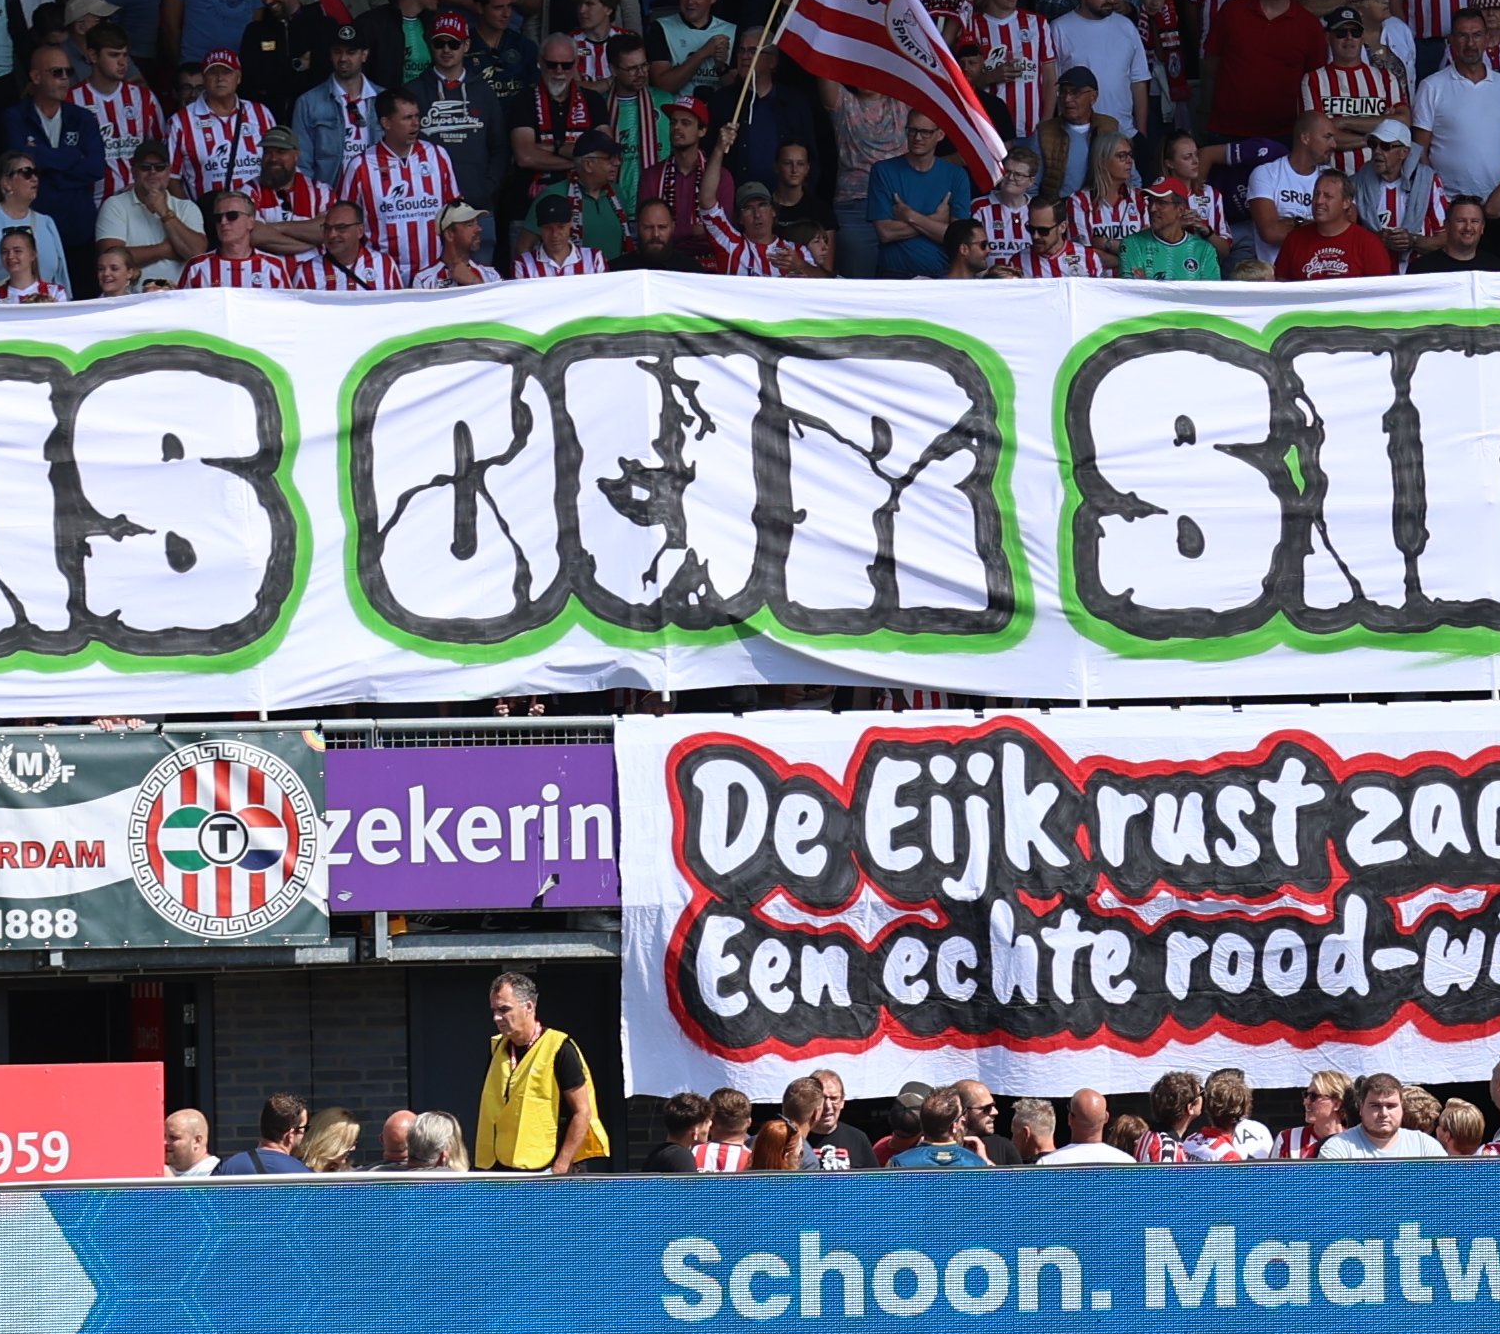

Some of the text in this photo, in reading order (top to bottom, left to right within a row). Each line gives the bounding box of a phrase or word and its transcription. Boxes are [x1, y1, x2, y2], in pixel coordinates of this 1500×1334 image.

[420, 107, 483, 131] Superdry
[1322, 98, 1386, 116] EFTELING
[204, 157, 217, 169] de
[378, 196, 437, 212] de Goudse
[695, 758, 830, 878] De
[864, 741, 1070, 902] Eijk
[1098, 756, 1327, 868] rust
[209, 824, 238, 854] T
[698, 913, 853, 1018] Een
[882, 898, 1138, 1007] echte
[661, 1229, 1112, 1322] Schoon.
